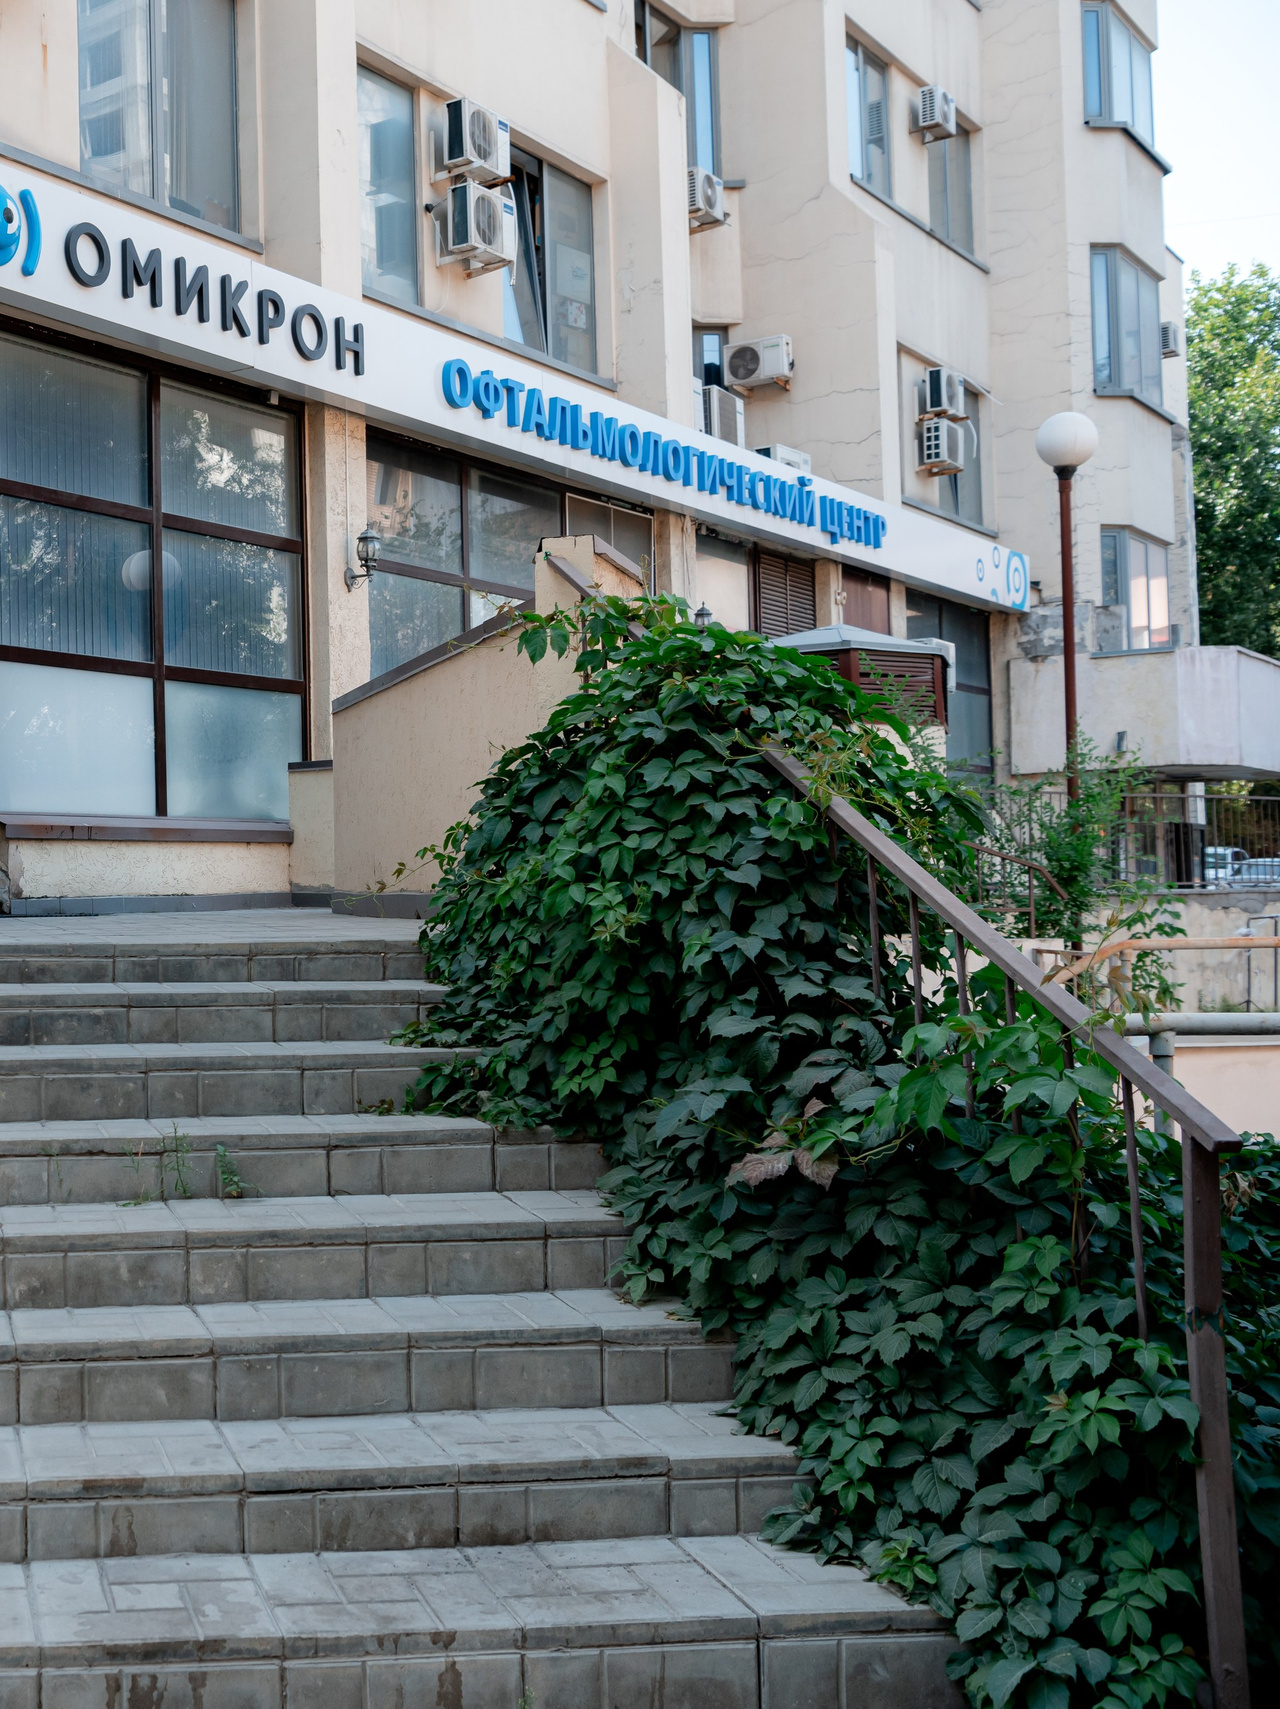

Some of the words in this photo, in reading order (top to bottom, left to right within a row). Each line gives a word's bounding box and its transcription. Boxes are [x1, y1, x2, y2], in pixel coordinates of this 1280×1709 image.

[65, 222, 365, 376] ОМИКРОН
[442, 358, 816, 527] ОФТАЛЬМОЛОГИЧЕСКИЙ
[819, 495, 887, 549] ЦЕНТР
